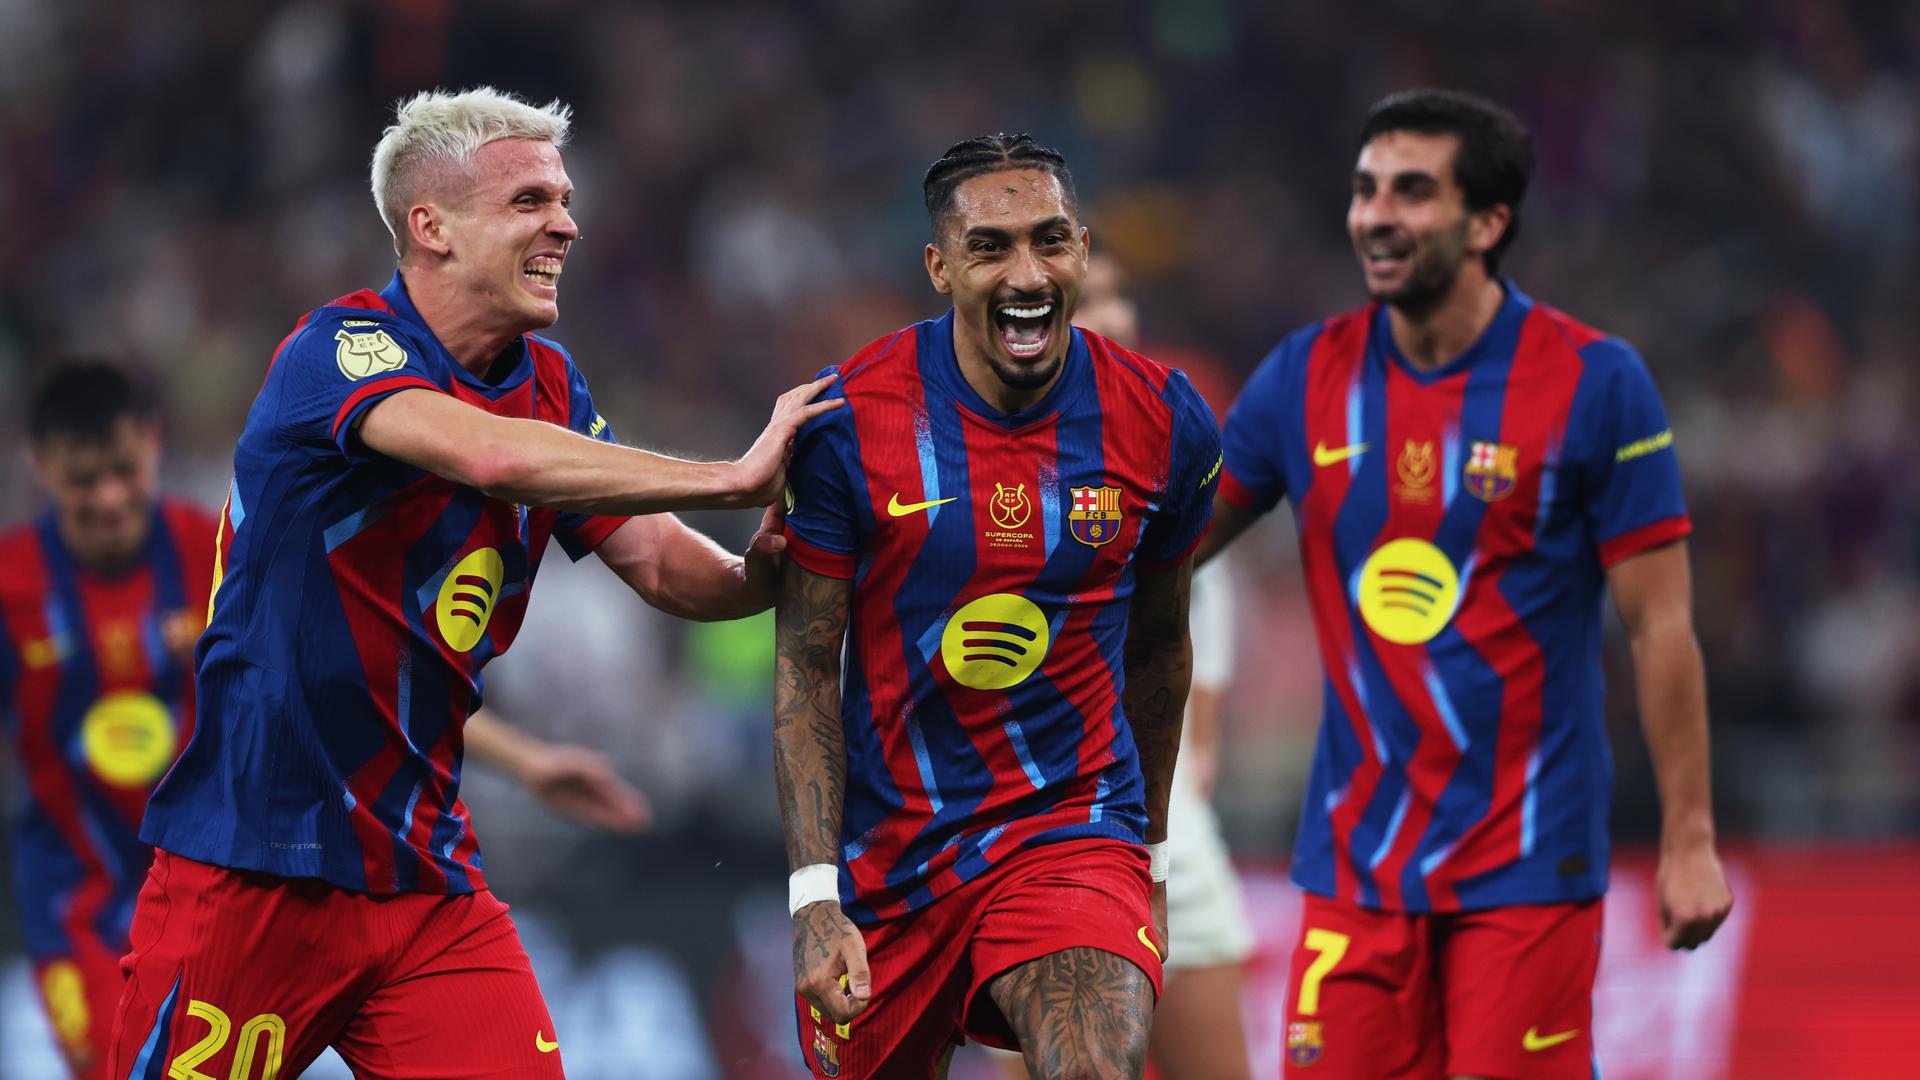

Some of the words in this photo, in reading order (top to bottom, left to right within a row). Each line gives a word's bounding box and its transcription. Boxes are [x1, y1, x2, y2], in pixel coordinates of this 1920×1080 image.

[1085, 511, 1107, 520] FCB
[1297, 927, 1351, 1016] 7
[167, 999, 287, 1080] 20
